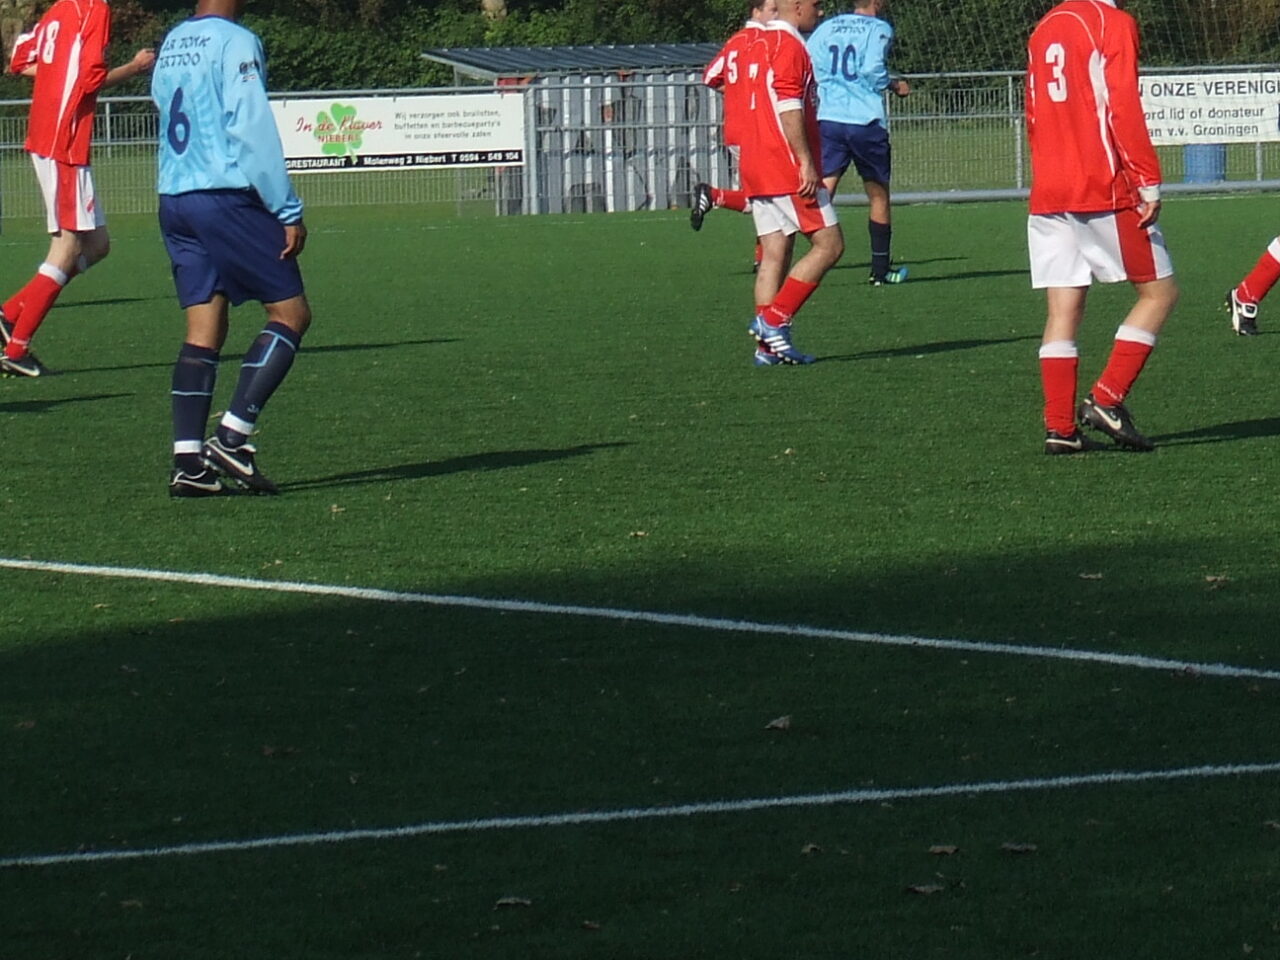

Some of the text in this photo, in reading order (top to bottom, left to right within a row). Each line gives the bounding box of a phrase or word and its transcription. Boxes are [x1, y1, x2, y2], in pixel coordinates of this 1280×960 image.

[727, 49, 738, 85] 5
[828, 44, 859, 82] 10
[1045, 43, 1068, 103] 3
[1151, 82, 1196, 97] ONZE
[168, 86, 191, 155] 6
[1170, 107, 1185, 120] lid
[1190, 107, 1202, 119] of
[1208, 106, 1265, 119] donateur
[295, 116, 313, 132] In
[317, 116, 335, 132] de
[431, 121, 440, 129] en
[1167, 127, 1189, 136] v.v.
[1193, 124, 1259, 138] Groningen
[451, 153, 457, 162] T
